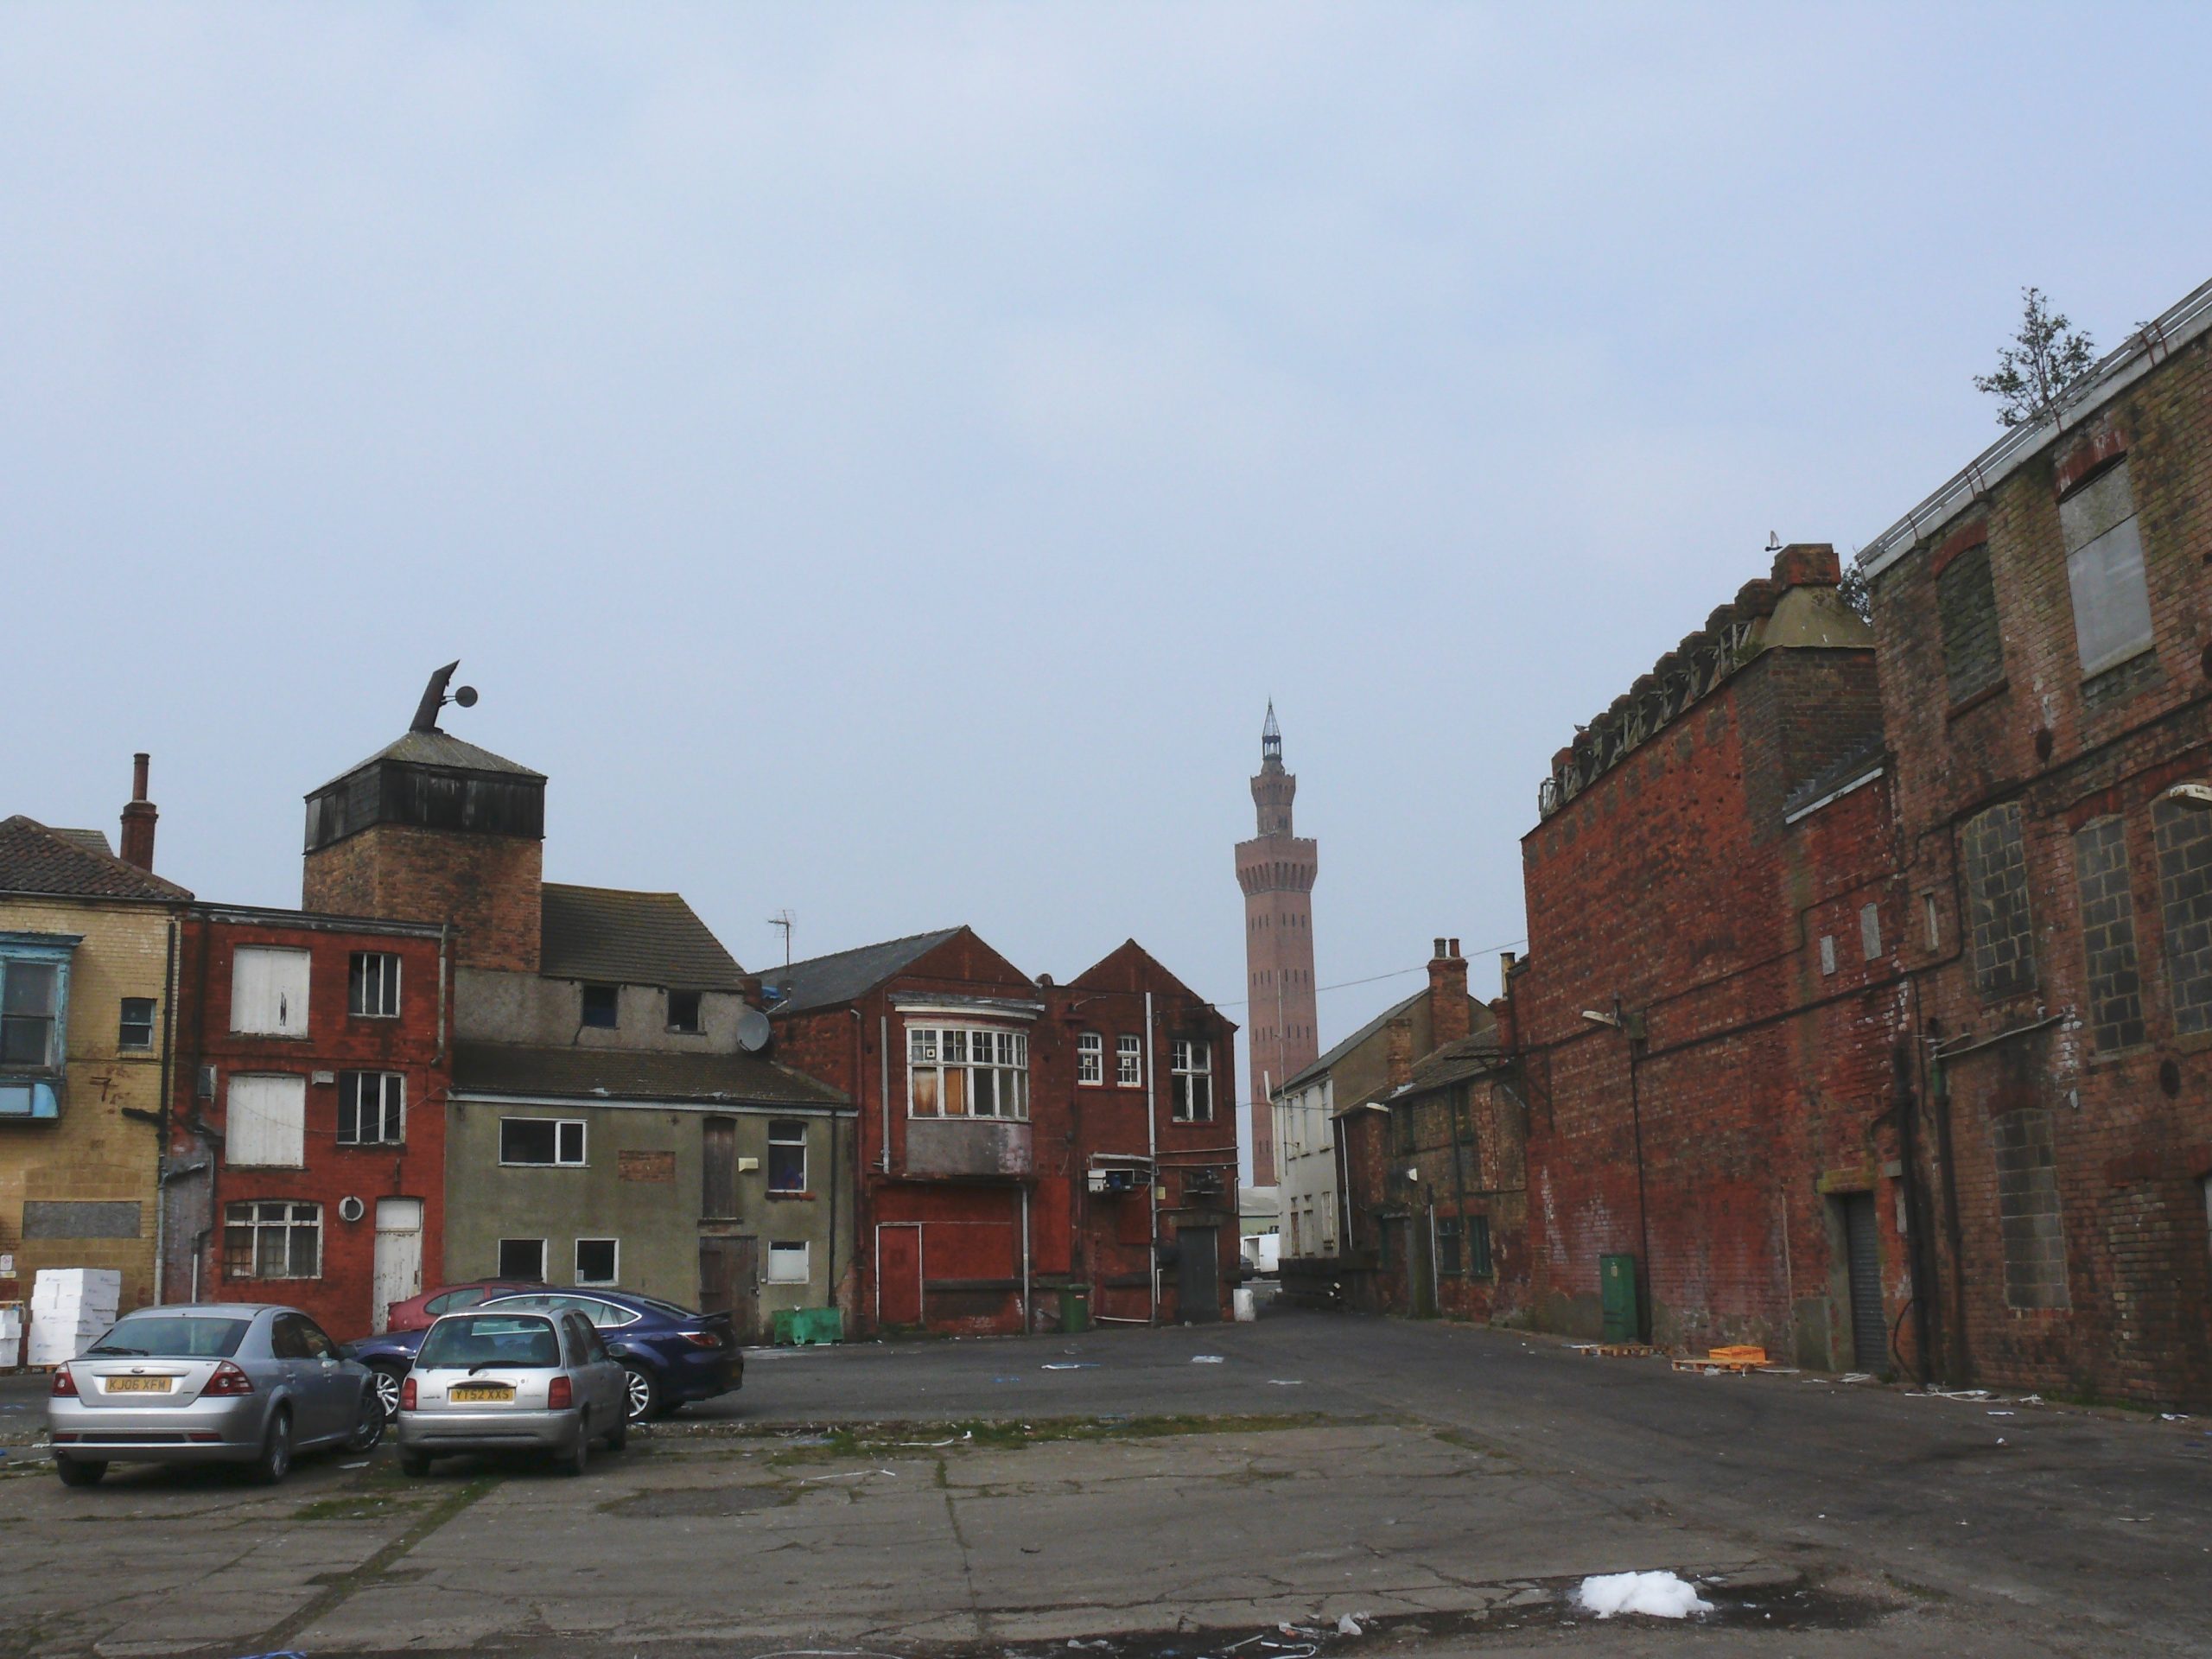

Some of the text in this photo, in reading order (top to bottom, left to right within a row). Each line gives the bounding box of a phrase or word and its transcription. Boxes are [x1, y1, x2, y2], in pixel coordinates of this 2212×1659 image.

[109, 1378, 166, 1390] KJ06 XFM
[455, 1389, 510, 1400] YT52 XXS
